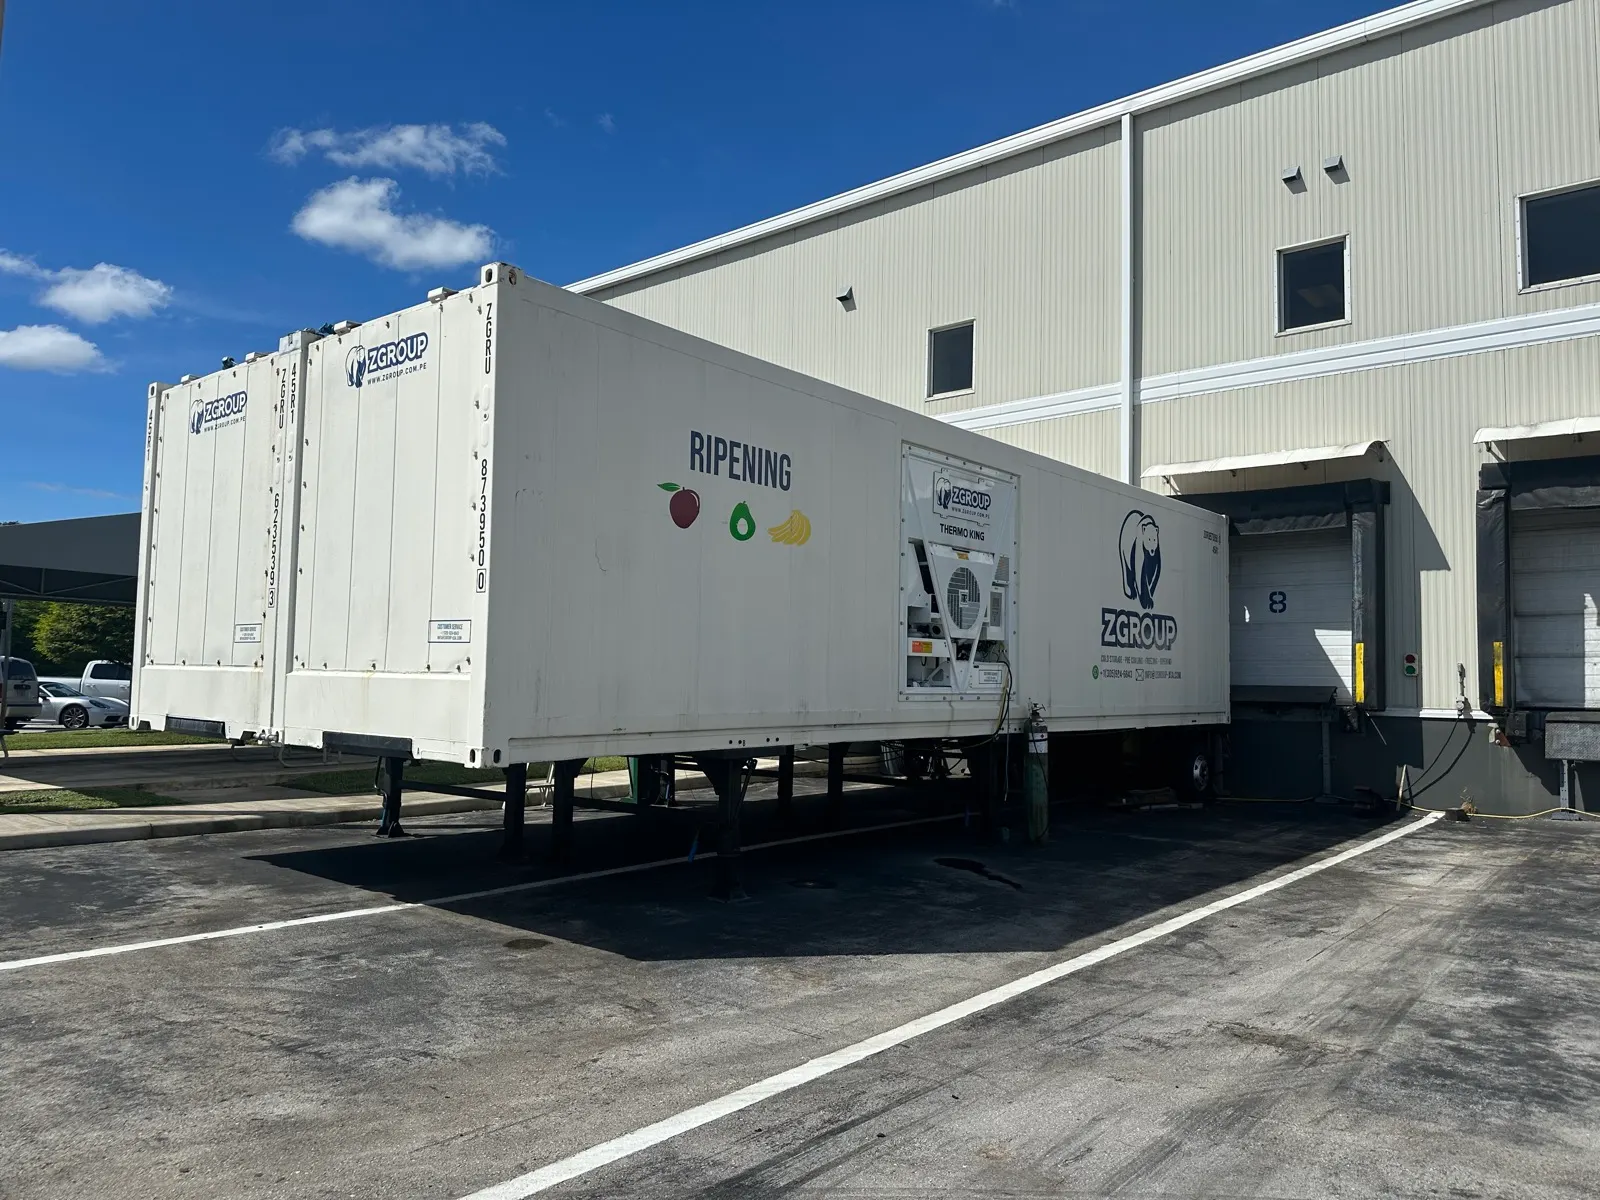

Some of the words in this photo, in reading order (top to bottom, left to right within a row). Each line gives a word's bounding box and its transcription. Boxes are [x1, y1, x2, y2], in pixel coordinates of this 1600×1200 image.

[367, 332, 428, 374] ZGROUP
[367, 362, 427, 386] WWW.ZGROUP.COM.PE
[204, 391, 247, 423] ZGROUP
[279, 368, 287, 429] ZGRU
[690, 430, 791, 491] RIPENING
[951, 486, 991, 510] ZGROUP
[940, 523, 968, 538] THERMO
[969, 529, 985, 541] KING
[1269, 591, 1287, 613] 8
[1101, 608, 1177, 651] ZGROUP
